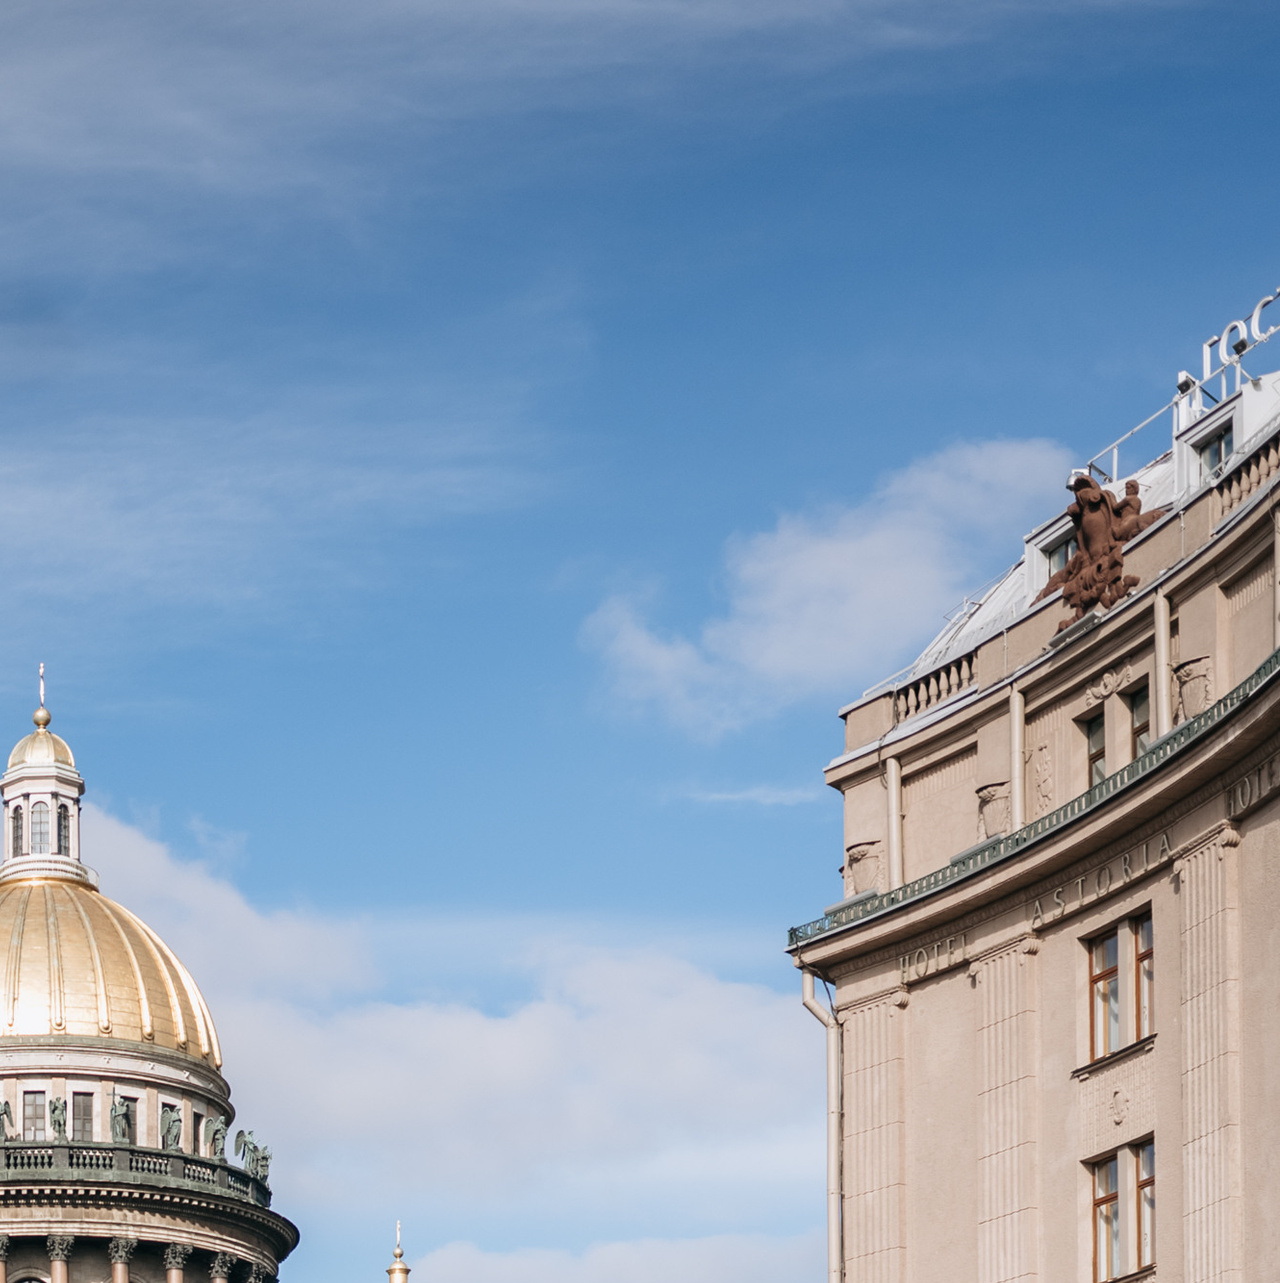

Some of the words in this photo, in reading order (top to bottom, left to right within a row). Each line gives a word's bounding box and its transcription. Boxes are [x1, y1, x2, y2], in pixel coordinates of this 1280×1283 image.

[1203, 286, 1280, 381] ГОС
[899, 934, 971, 984] HOTEL
[1031, 833, 1172, 929] ASTORIA
